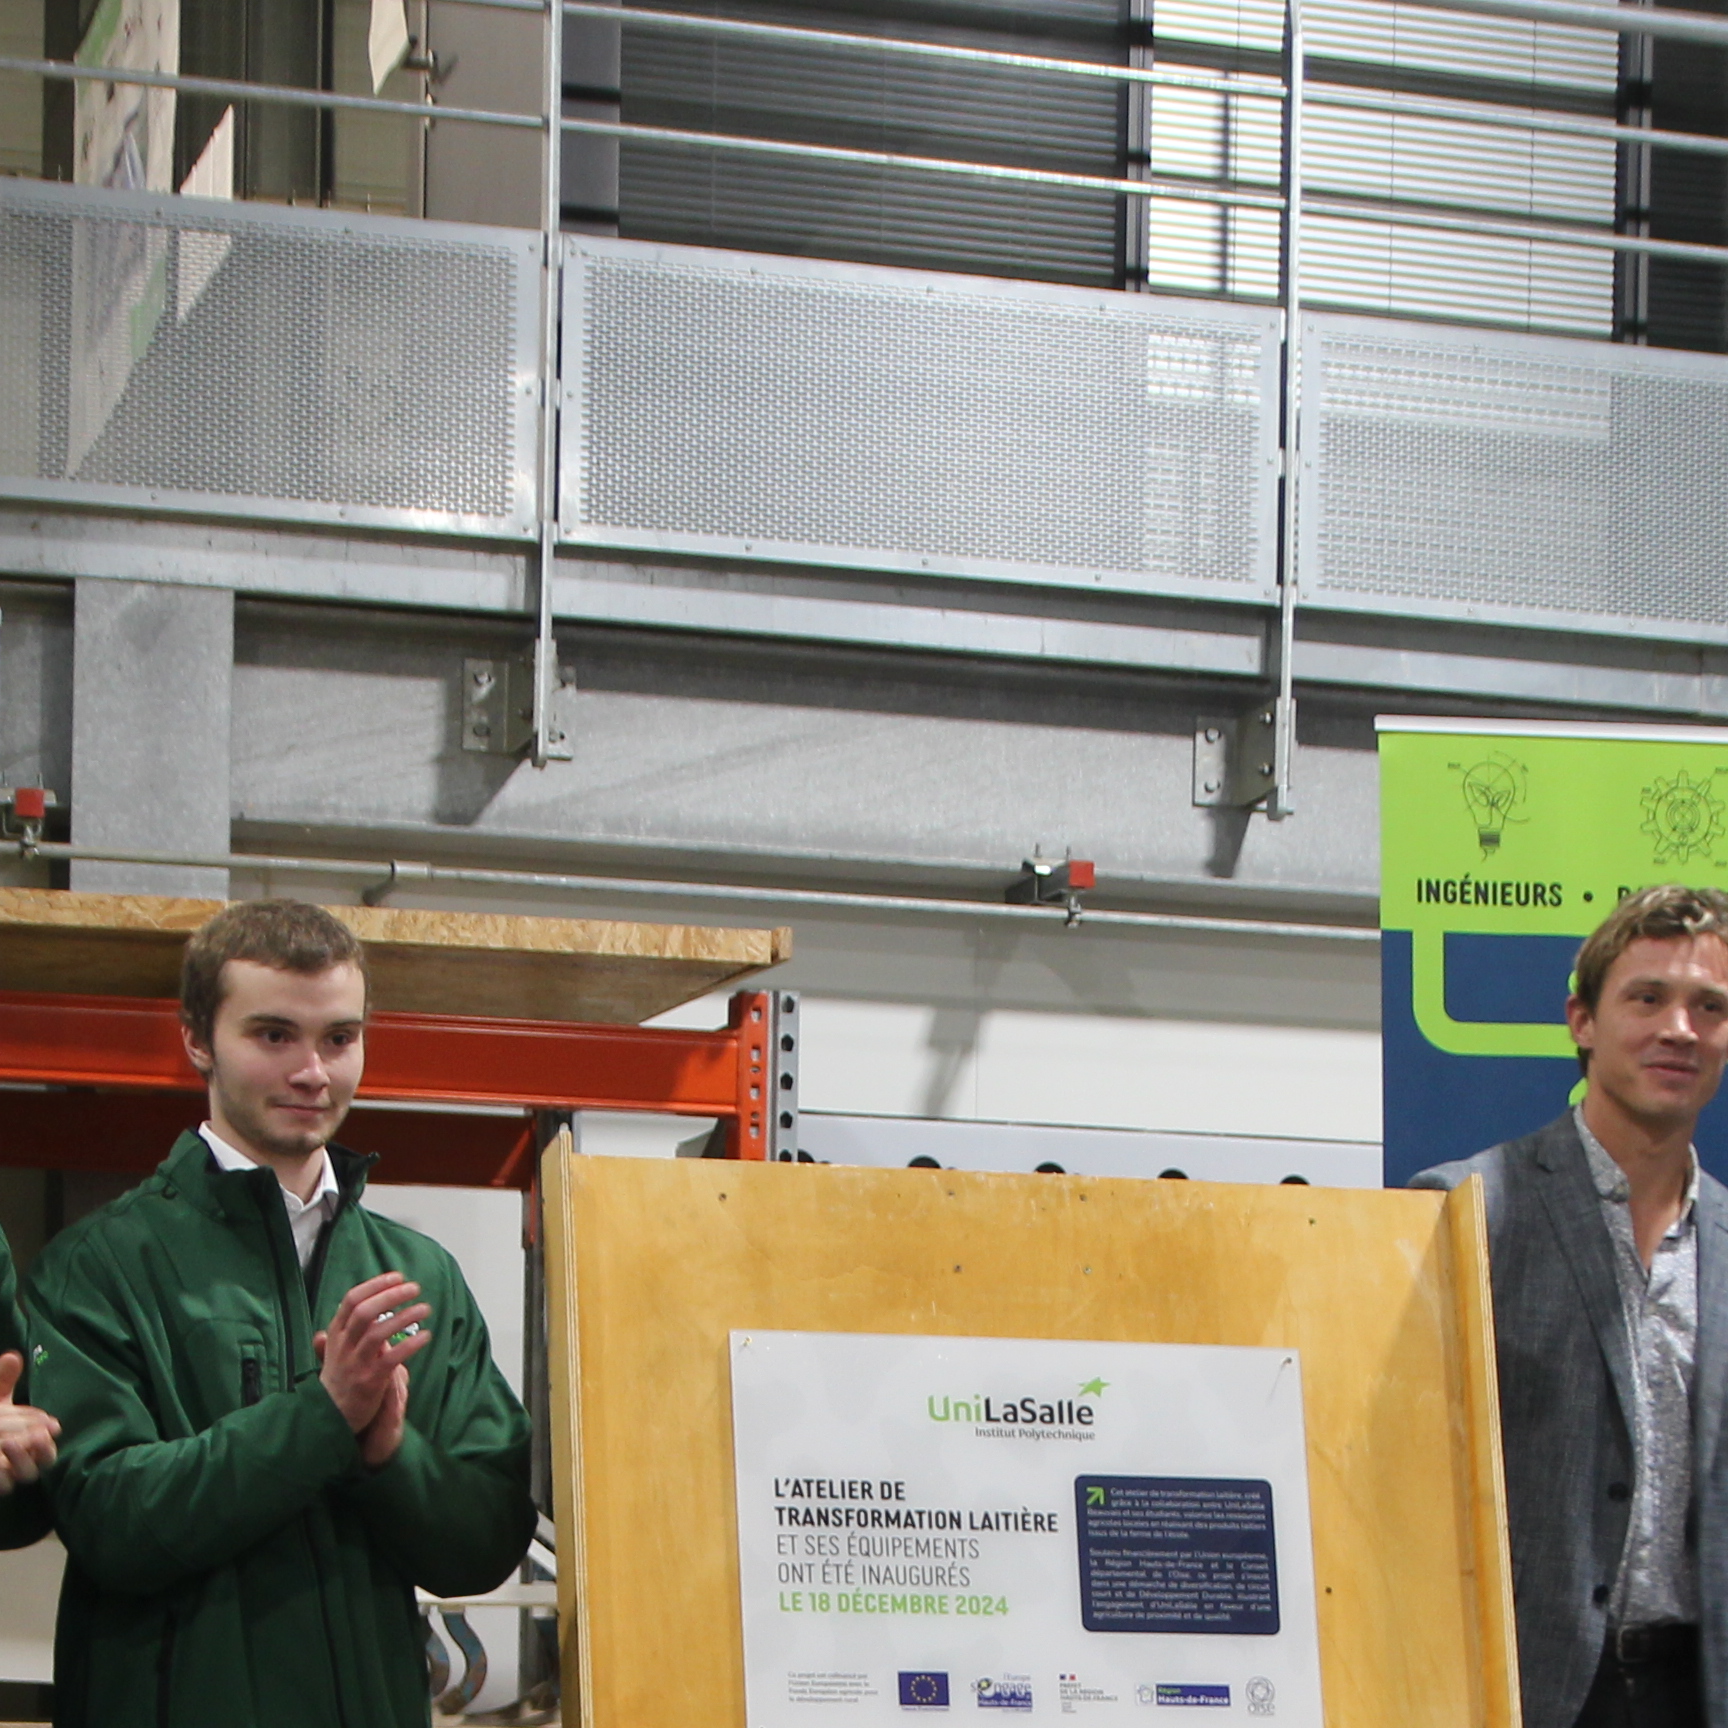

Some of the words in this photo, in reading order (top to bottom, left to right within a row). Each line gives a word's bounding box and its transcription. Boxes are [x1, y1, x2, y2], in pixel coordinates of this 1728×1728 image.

[1416, 873, 1563, 908] INGÉNIEURS
[927, 1394, 1095, 1426] UniLaSalle
[975, 1426, 1015, 1439] Institut
[1018, 1429, 1095, 1442] Polytechnique
[880, 1481, 906, 1501] DE
[774, 1506, 962, 1530] TRANSFORMATION
[969, 1506, 1059, 1533] LAITIÈRE
[776, 1534, 798, 1555] ET
[804, 1535, 839, 1556] SES
[847, 1531, 979, 1559] ÉQUIPEMENTS
[777, 1562, 814, 1584] ONT
[822, 1559, 855, 1586] ÉTÉ
[862, 1561, 971, 1587] INAUGURÉS
[780, 1592, 803, 1612] LE
[810, 1592, 831, 1612] 18
[838, 1587, 949, 1614] DÉCEMBRE
[956, 1596, 1009, 1615] 2024
